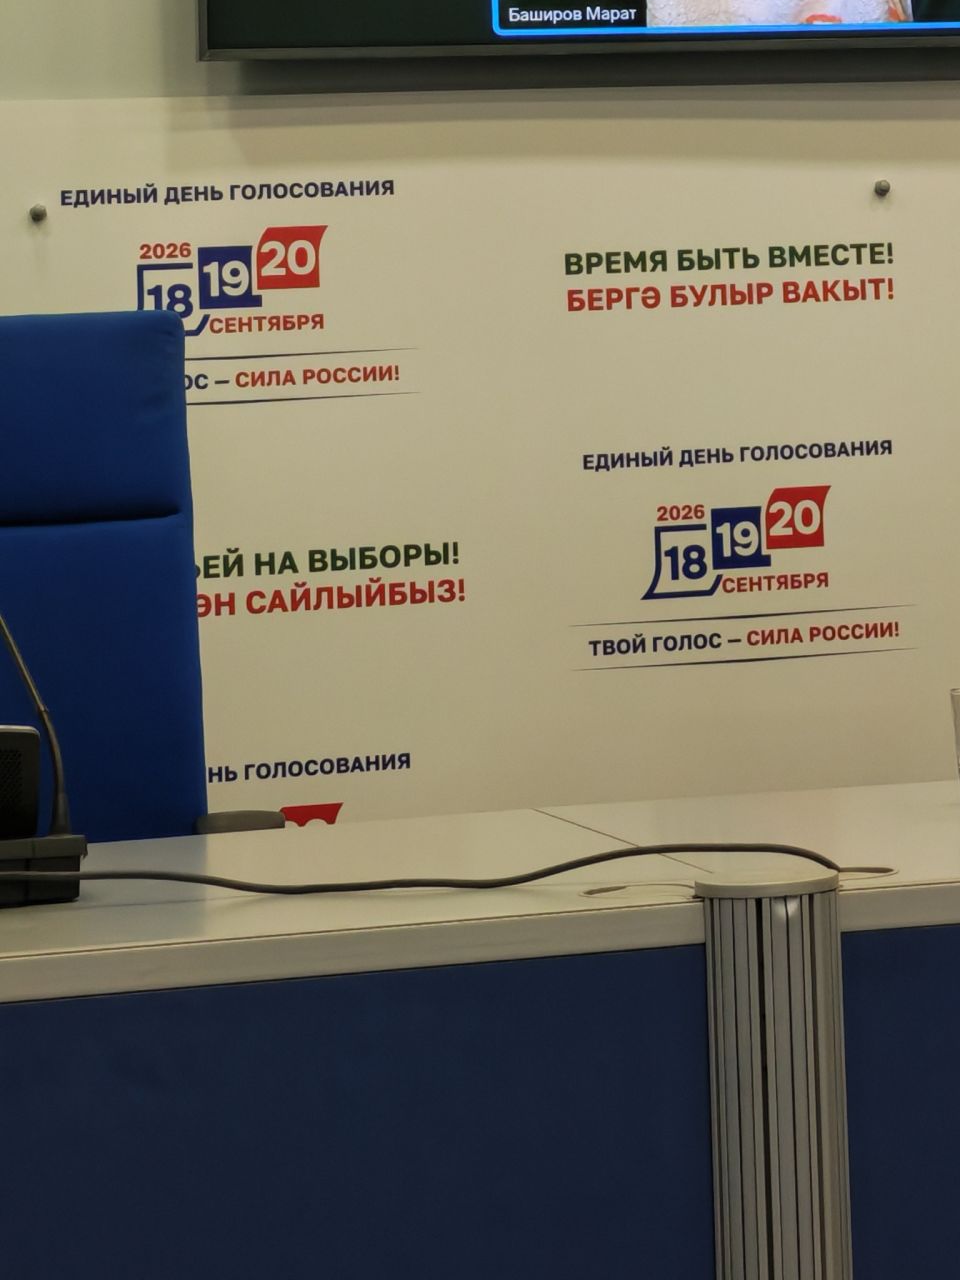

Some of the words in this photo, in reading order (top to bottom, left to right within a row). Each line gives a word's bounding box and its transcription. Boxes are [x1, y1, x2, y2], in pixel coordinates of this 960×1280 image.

[509, 8, 582, 24] Баширов
[587, 7, 636, 23] Марат
[61, 183, 157, 208] ЕДИНЫЙ
[164, 186, 223, 205] ДЕНЬ
[230, 180, 394, 200] ГОЛОСОВАНИЯ
[140, 243, 191, 259] 2026
[565, 250, 667, 275] ВРЕМЯ
[678, 248, 759, 271] БЫТЬ
[769, 243, 893, 268] ВМЕСТЕ!
[147, 284, 193, 318] 18
[203, 260, 250, 296] 19
[260, 241, 316, 276] 20
[671, 283, 773, 307] БУЛЫР
[783, 278, 893, 303] ВАКЫТ!
[210, 314, 324, 334] СЕНТЯБРЯ
[236, 370, 296, 387] СИЛА
[303, 366, 399, 384] РОССИИ!
[583, 446, 673, 472] ЕДИНЫЙ
[679, 448, 734, 467] ДЕНЬ
[740, 440, 892, 462] ГОЛОСОВАНИЯ
[657, 505, 704, 521] 2026
[664, 545, 707, 580] 18
[716, 521, 761, 558] 19
[769, 500, 821, 537] 20
[255, 551, 298, 575] НА
[309, 542, 458, 572] ВЫБОРЫ!
[246, 577, 465, 614] САЙЛЫЙБЫЗ!
[722, 572, 829, 594] СЕНТЯБРЯ
[589, 634, 645, 656] ТВОЙ
[653, 633, 721, 652] ГОЛОС
[747, 628, 803, 646] СИЛА
[810, 622, 899, 642] РОССИИ!
[208, 767, 238, 783] НЬ
[245, 753, 410, 780] ГОЛОСОВАНИЯ
